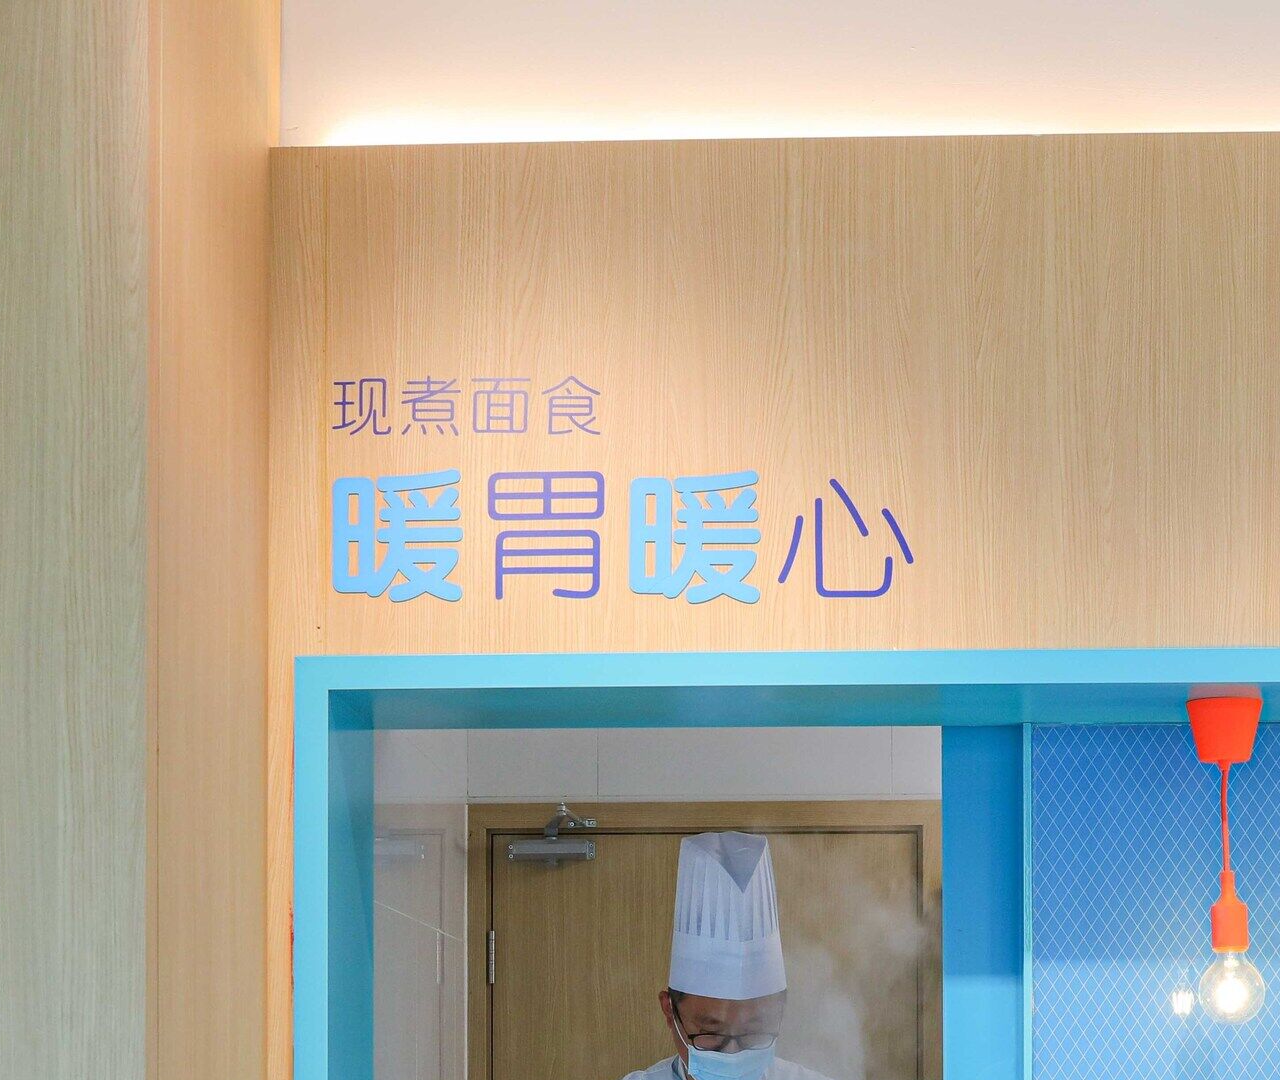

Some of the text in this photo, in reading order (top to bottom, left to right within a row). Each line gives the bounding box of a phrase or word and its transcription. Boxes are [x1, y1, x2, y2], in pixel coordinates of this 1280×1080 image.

[331, 375, 601, 436] 现煮面食
[331, 469, 914, 605] 暖胃暖心
